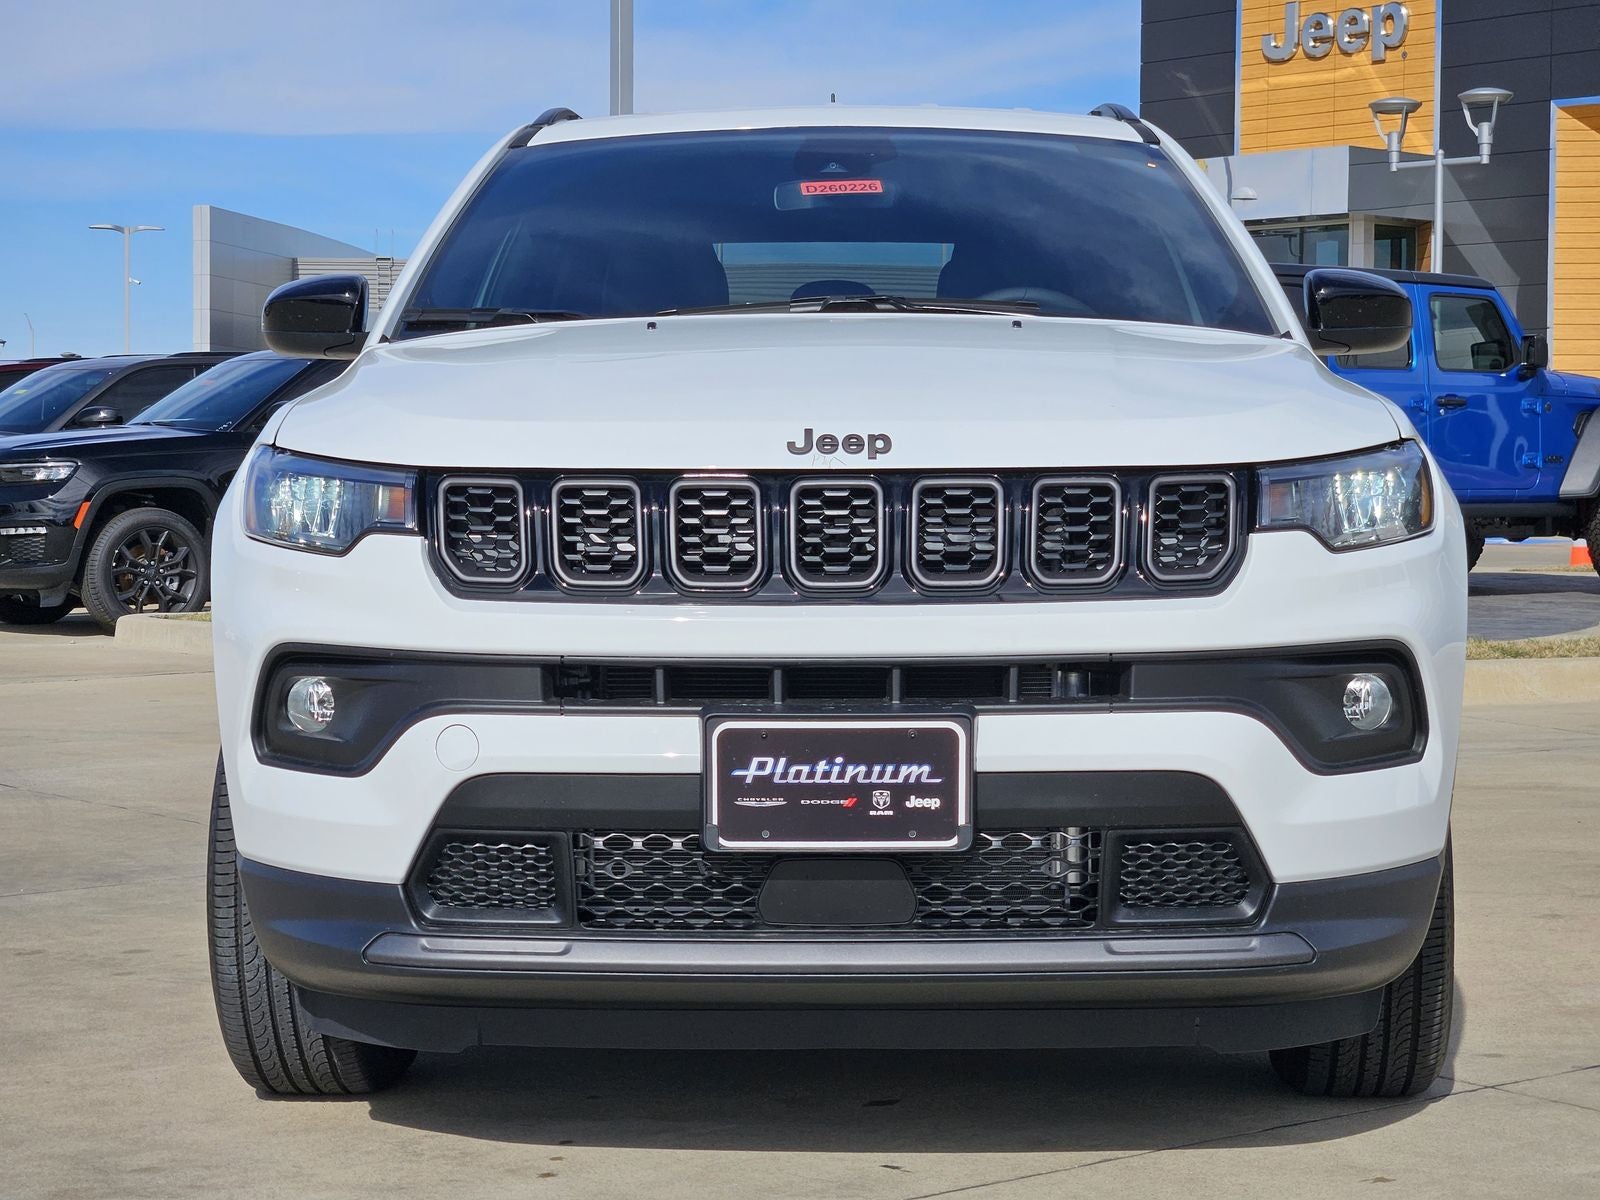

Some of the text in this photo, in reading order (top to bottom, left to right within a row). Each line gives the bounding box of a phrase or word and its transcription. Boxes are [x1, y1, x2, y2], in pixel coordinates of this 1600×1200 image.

[1261, 1, 1408, 64] Jeep
[805, 183, 878, 193] D260226
[786, 428, 892, 460] Jeep
[730, 756, 943, 784] Platinum
[905, 795, 941, 810] Jeep
